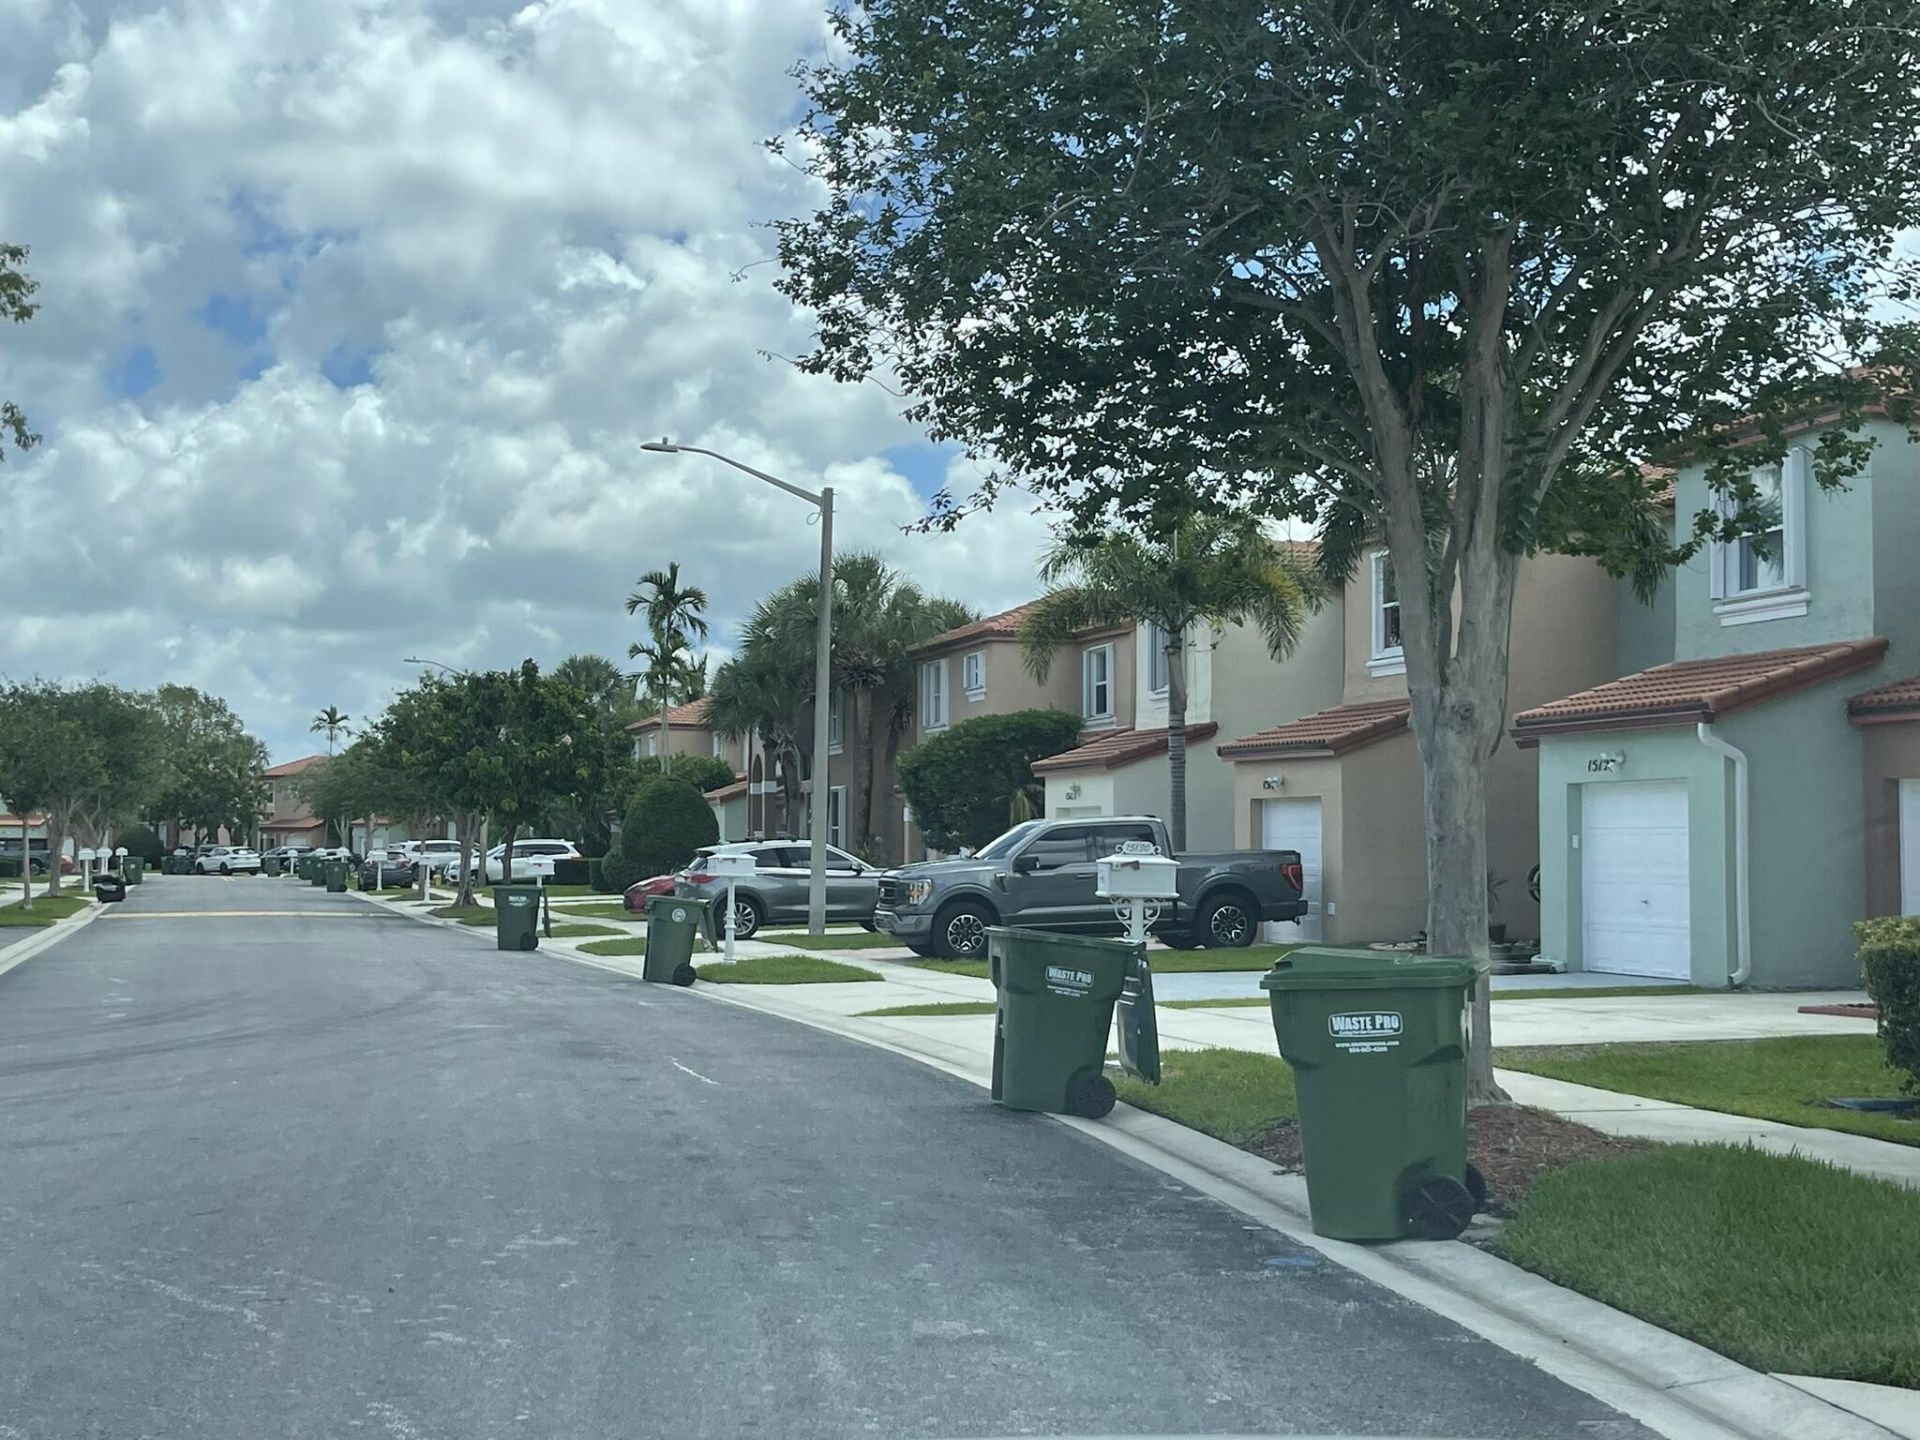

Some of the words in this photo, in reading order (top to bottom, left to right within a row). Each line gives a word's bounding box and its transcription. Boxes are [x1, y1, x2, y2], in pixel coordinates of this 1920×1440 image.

[1048, 967, 1075, 981] WASTE
[1076, 971, 1092, 983] PRO
[1332, 1016, 1373, 1031] WASTE
[1374, 1014, 1399, 1029] PRO
